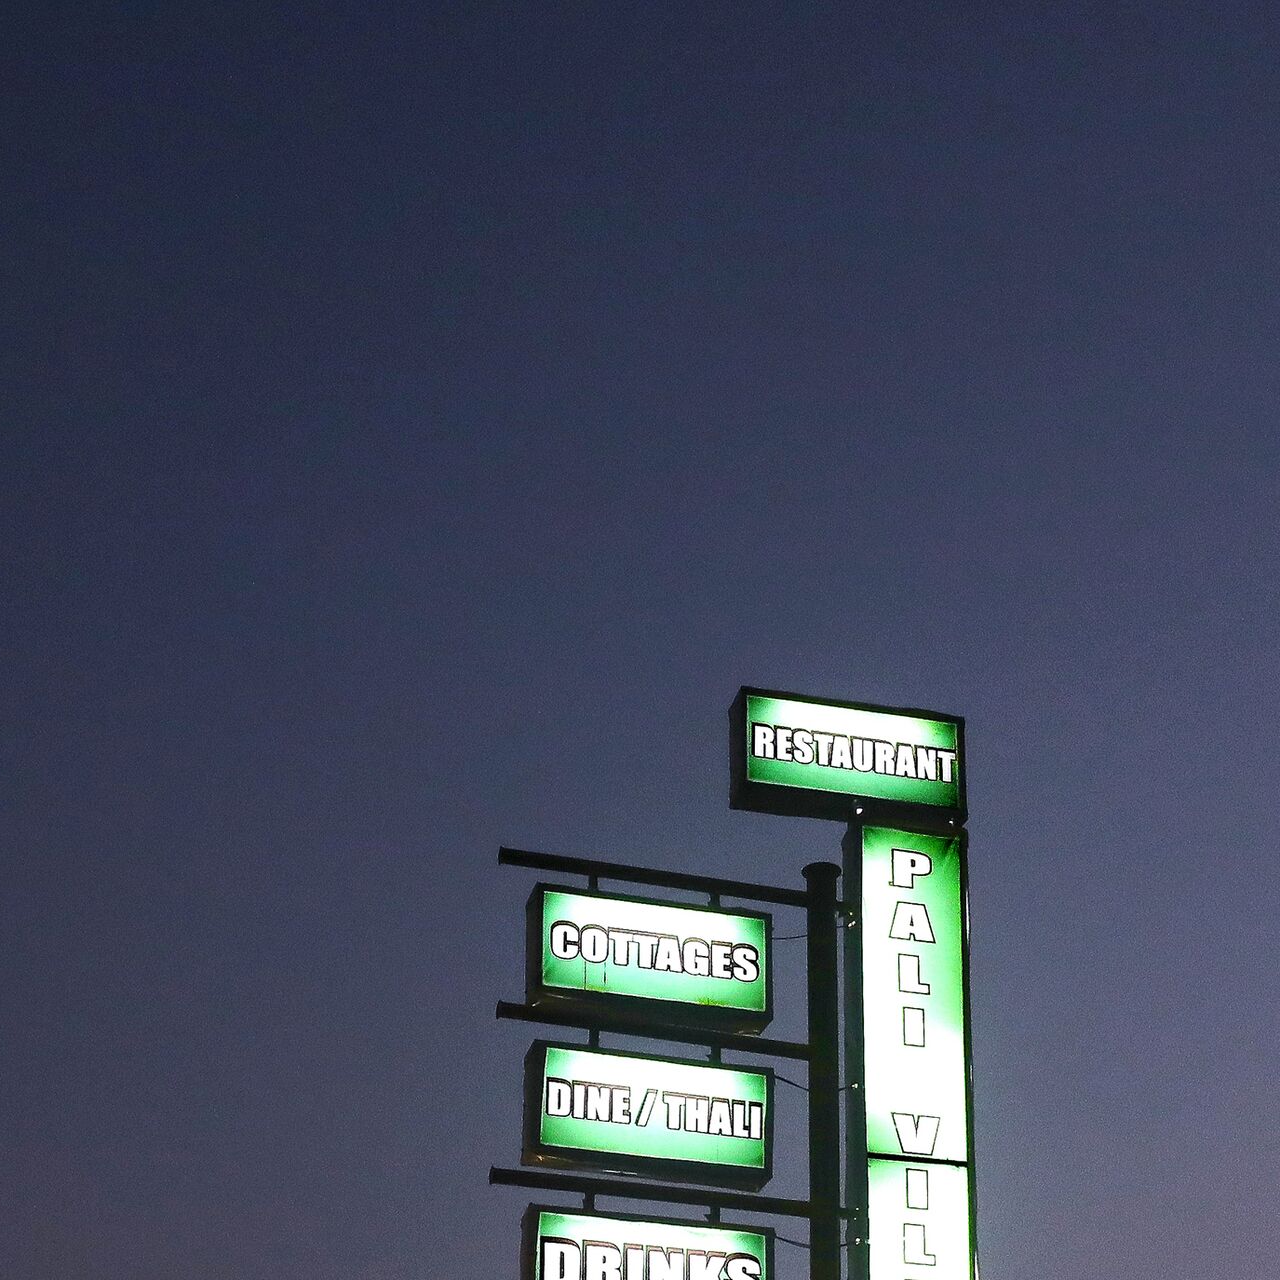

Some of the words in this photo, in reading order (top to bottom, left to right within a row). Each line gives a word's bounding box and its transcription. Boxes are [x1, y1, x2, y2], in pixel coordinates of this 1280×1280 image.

[751, 723, 957, 783] RESTAURANT
[550, 920, 760, 983] COTTAGES
[888, 848, 936, 1047] PALI
[546, 1077, 631, 1124] DINE
[662, 1091, 763, 1140] THALI
